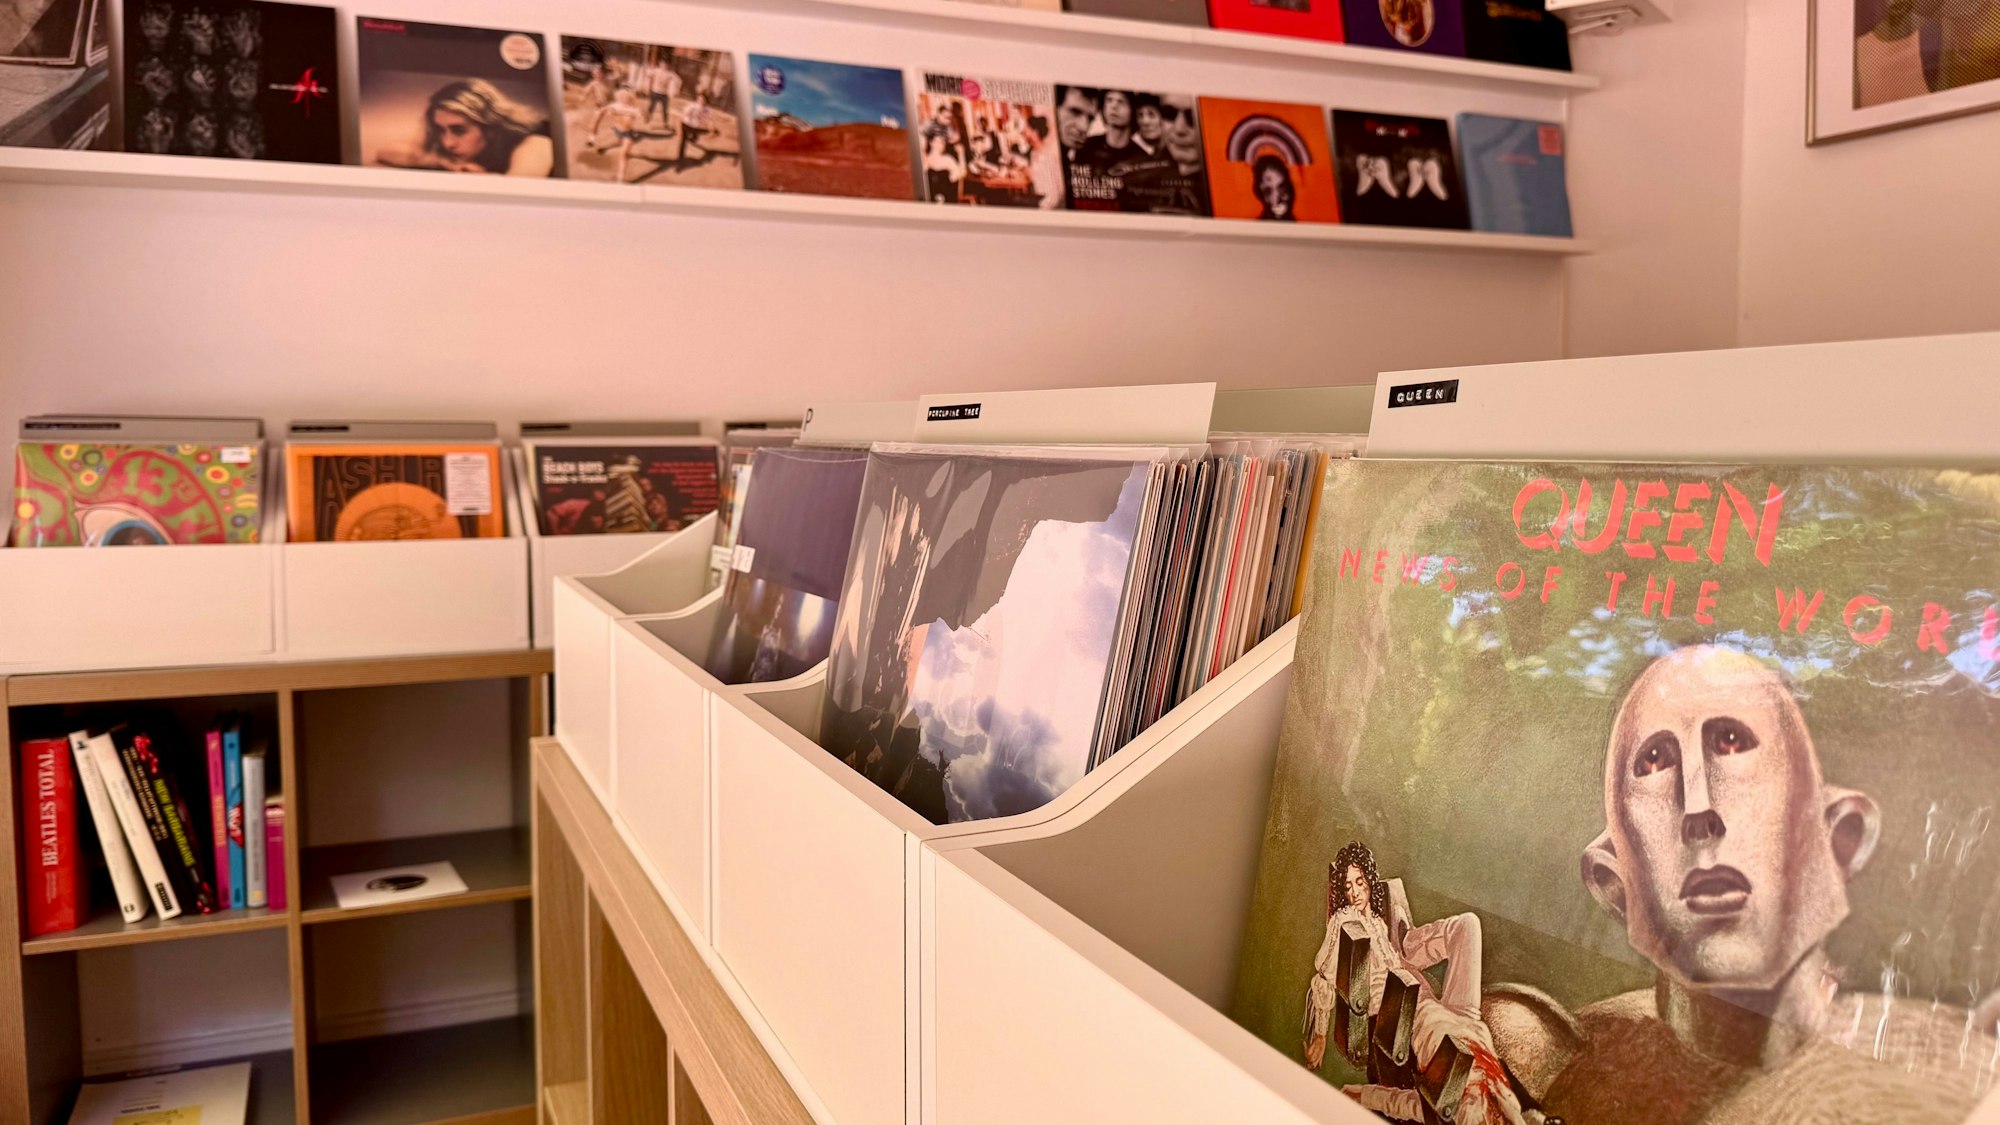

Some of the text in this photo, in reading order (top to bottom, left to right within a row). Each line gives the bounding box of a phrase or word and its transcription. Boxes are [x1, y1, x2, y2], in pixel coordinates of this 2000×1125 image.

[1070, 164, 1092, 177] THE
[1071, 176, 1124, 190] ROLLING
[1073, 188, 1117, 199] STONES
[1397, 388, 1444, 403] QUEEN
[1511, 477, 1784, 567] QUEEN
[1338, 546, 1459, 592] NEWS
[1496, 562, 1563, 604] OF
[1605, 571, 1720, 625] THE
[37, 748, 57, 799] TOTAL
[40, 802, 59, 866] BEATLES
